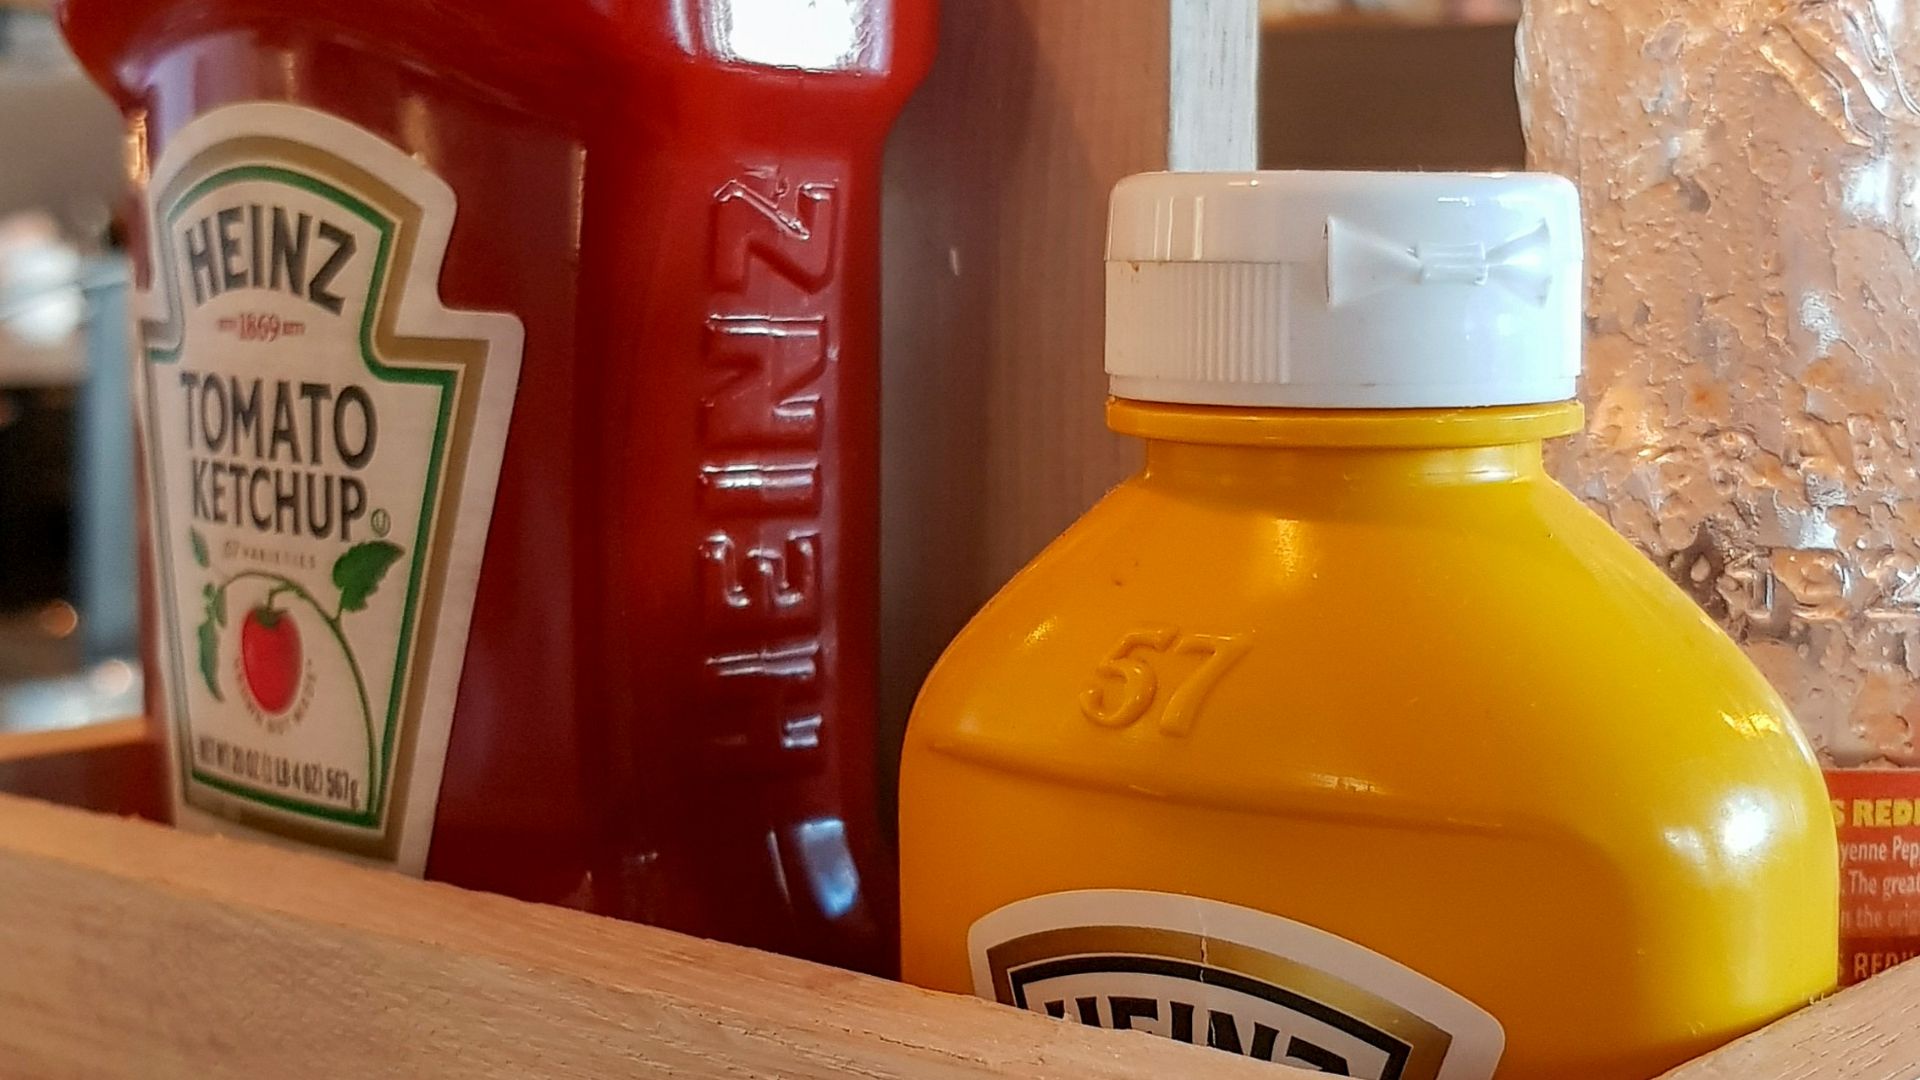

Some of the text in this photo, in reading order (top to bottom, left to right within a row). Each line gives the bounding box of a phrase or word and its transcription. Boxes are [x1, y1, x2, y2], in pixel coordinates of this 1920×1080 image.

[184, 203, 358, 317] HEINZ
[240, 312, 280, 342] 1869
[179, 371, 378, 471] TOMATO
[193, 459, 368, 543] KETCHUP
[704, 160, 838, 776] HEINZ
[1079, 624, 1256, 739] 57
[275, 756, 291, 788] LB
[292, 761, 301, 791] 4
[303, 762, 323, 795] OZ)
[1849, 870, 1877, 896] The
[1856, 904, 1882, 929] the
